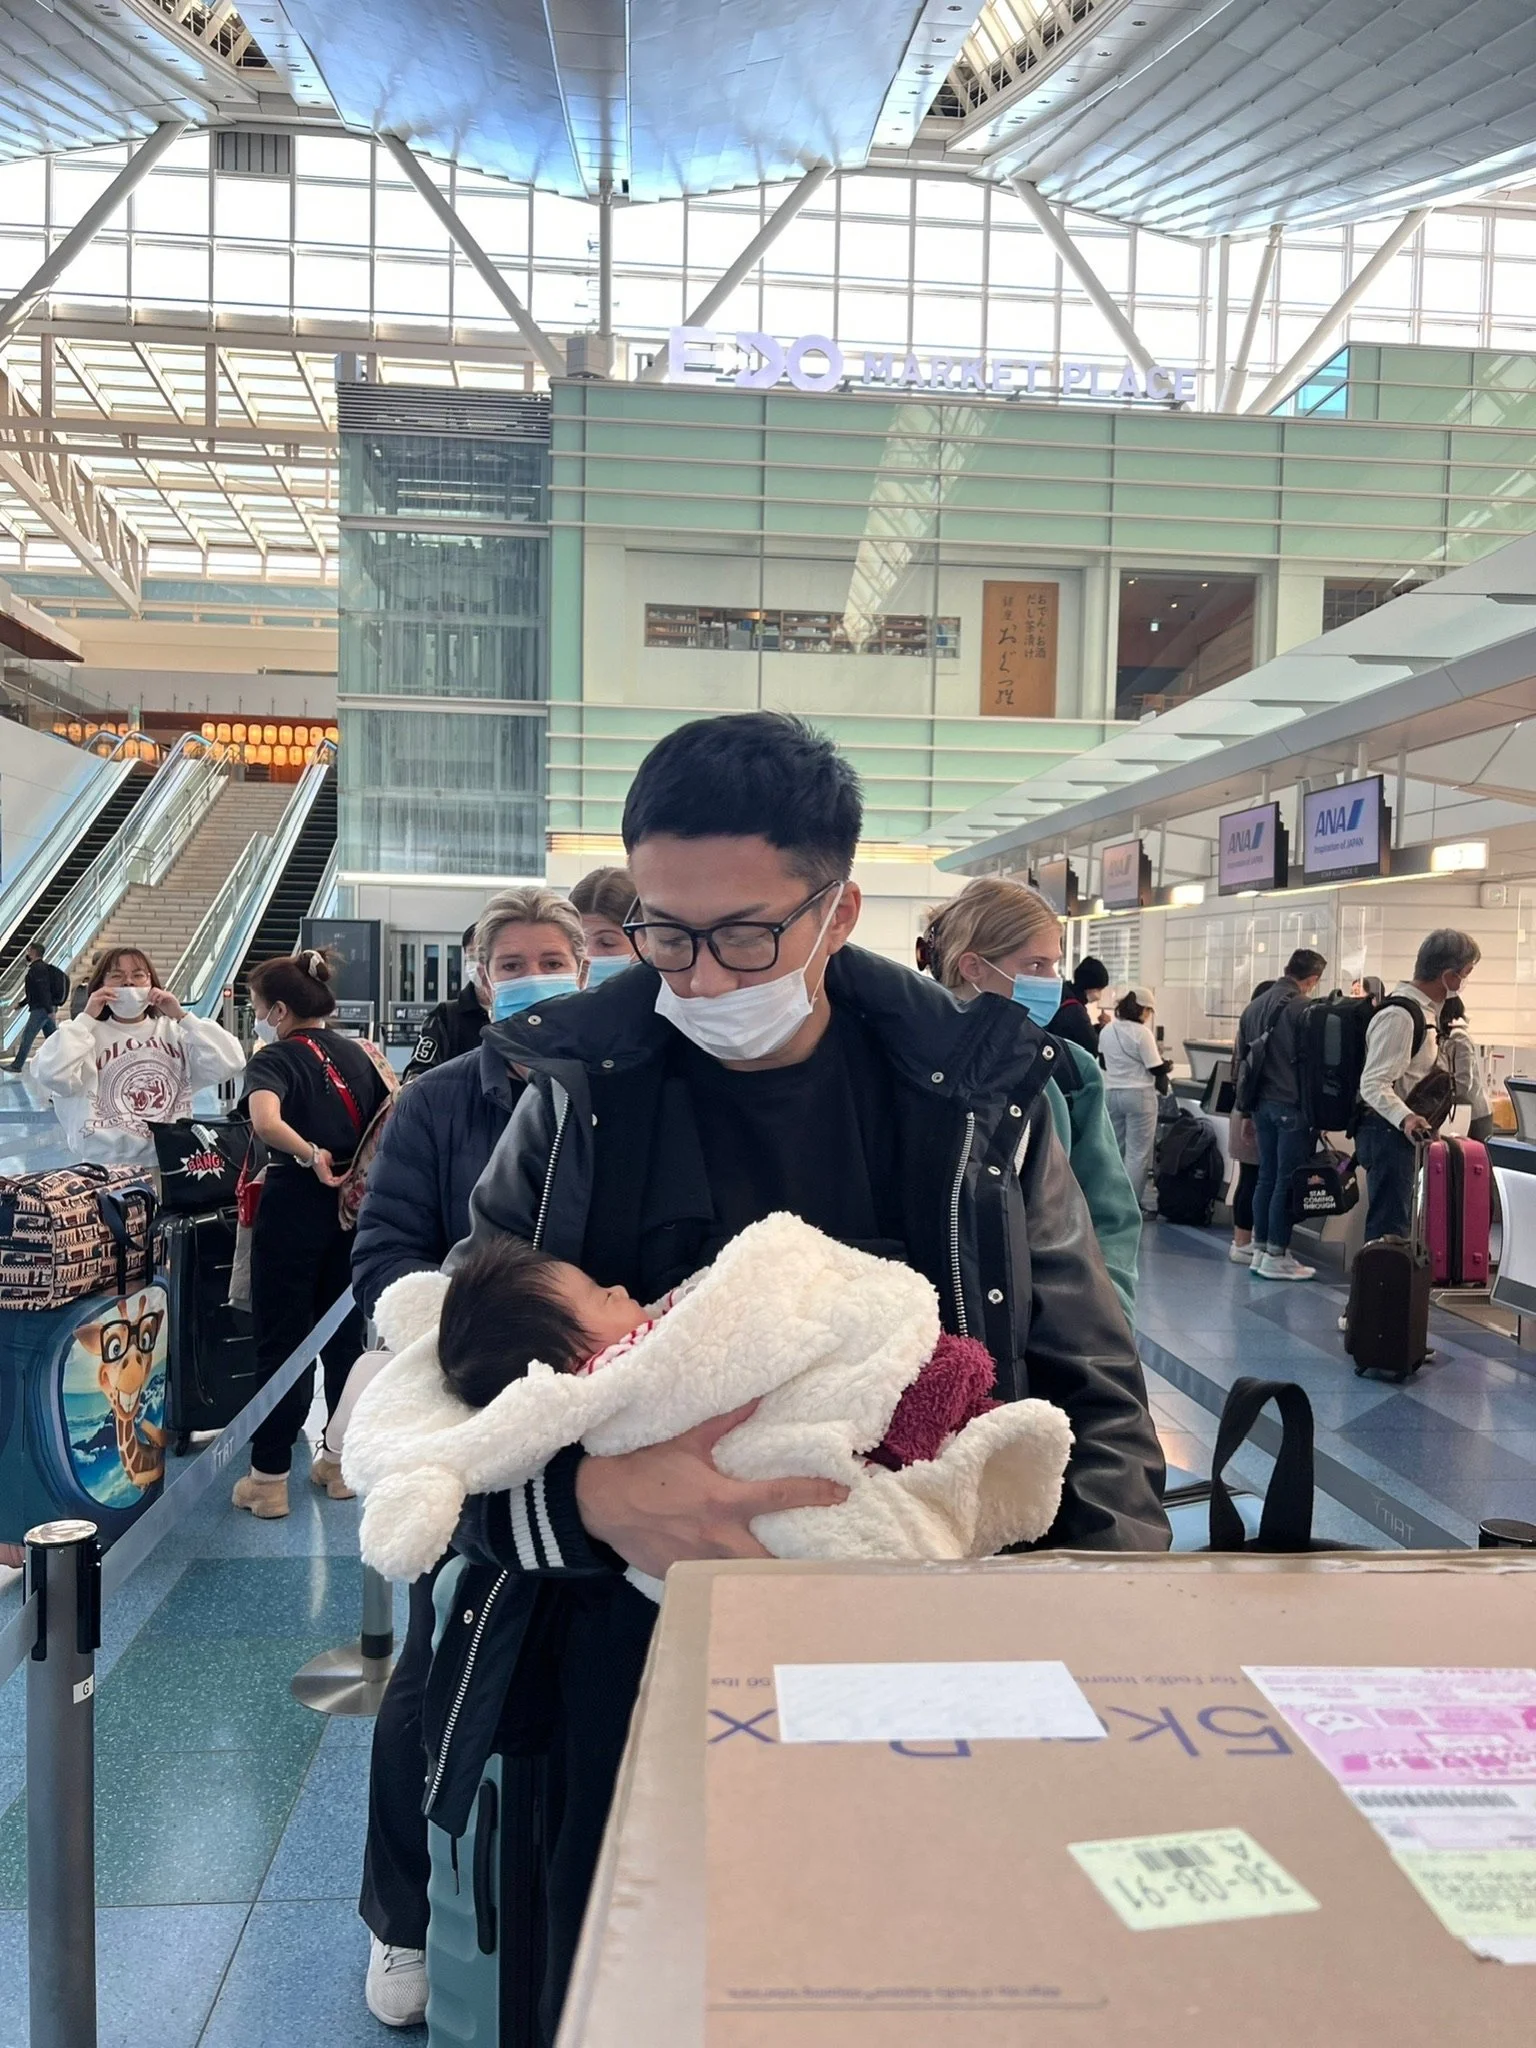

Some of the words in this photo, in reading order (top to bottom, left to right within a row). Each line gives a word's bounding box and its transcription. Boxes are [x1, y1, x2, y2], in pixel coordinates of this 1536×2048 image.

[668, 326, 844, 392] EDO
[862, 351, 1042, 393] MARKET
[1062, 362, 1196, 401] PLACE
[1314, 805, 1346, 838] ANA
[1227, 829, 1251, 855] ANA
[93, 1116, 124, 1127] CLASS
[1303, 1202, 1336, 1210] THROUGH
[82, 1681, 90, 1696] G
